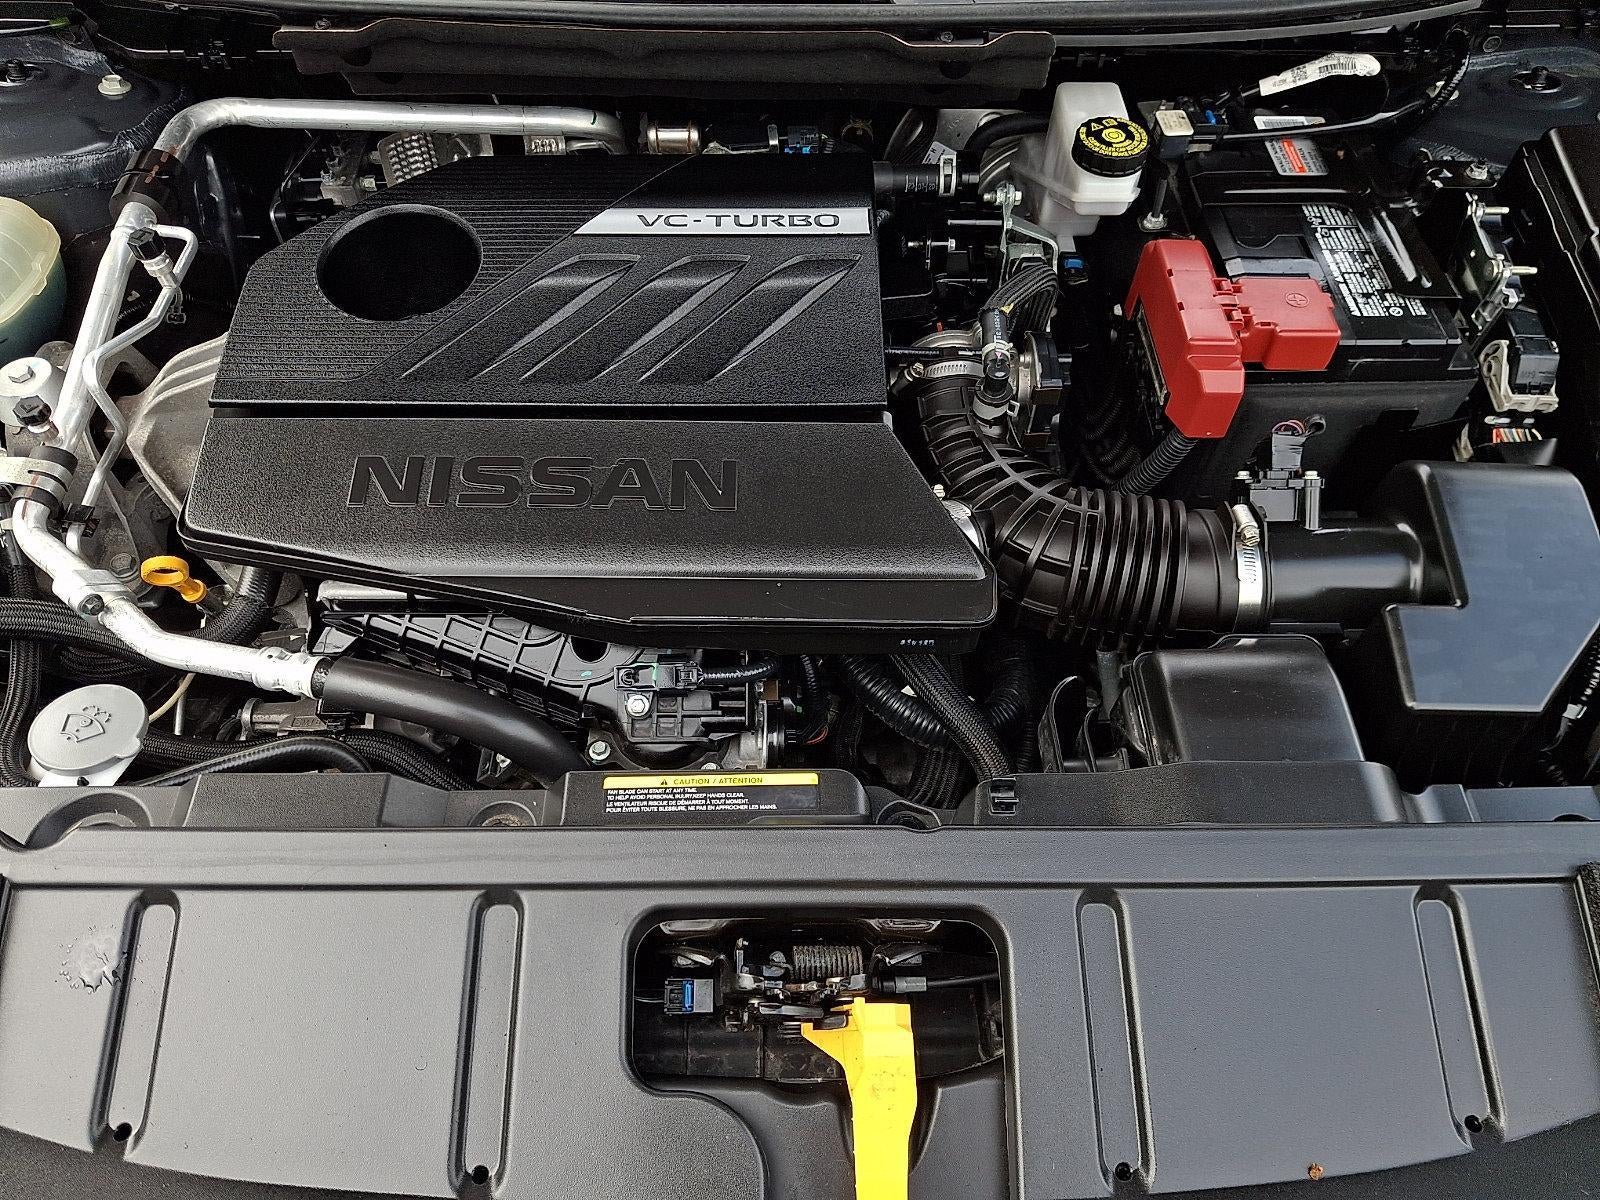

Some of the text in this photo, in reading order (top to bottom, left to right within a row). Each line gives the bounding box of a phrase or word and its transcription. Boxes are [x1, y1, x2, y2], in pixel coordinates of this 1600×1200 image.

[637, 213, 839, 227] VC-TURBO
[346, 455, 738, 512] NISSAN
[676, 798, 706, 806] DÉMARRER
[622, 805, 640, 813] ÉVITER
